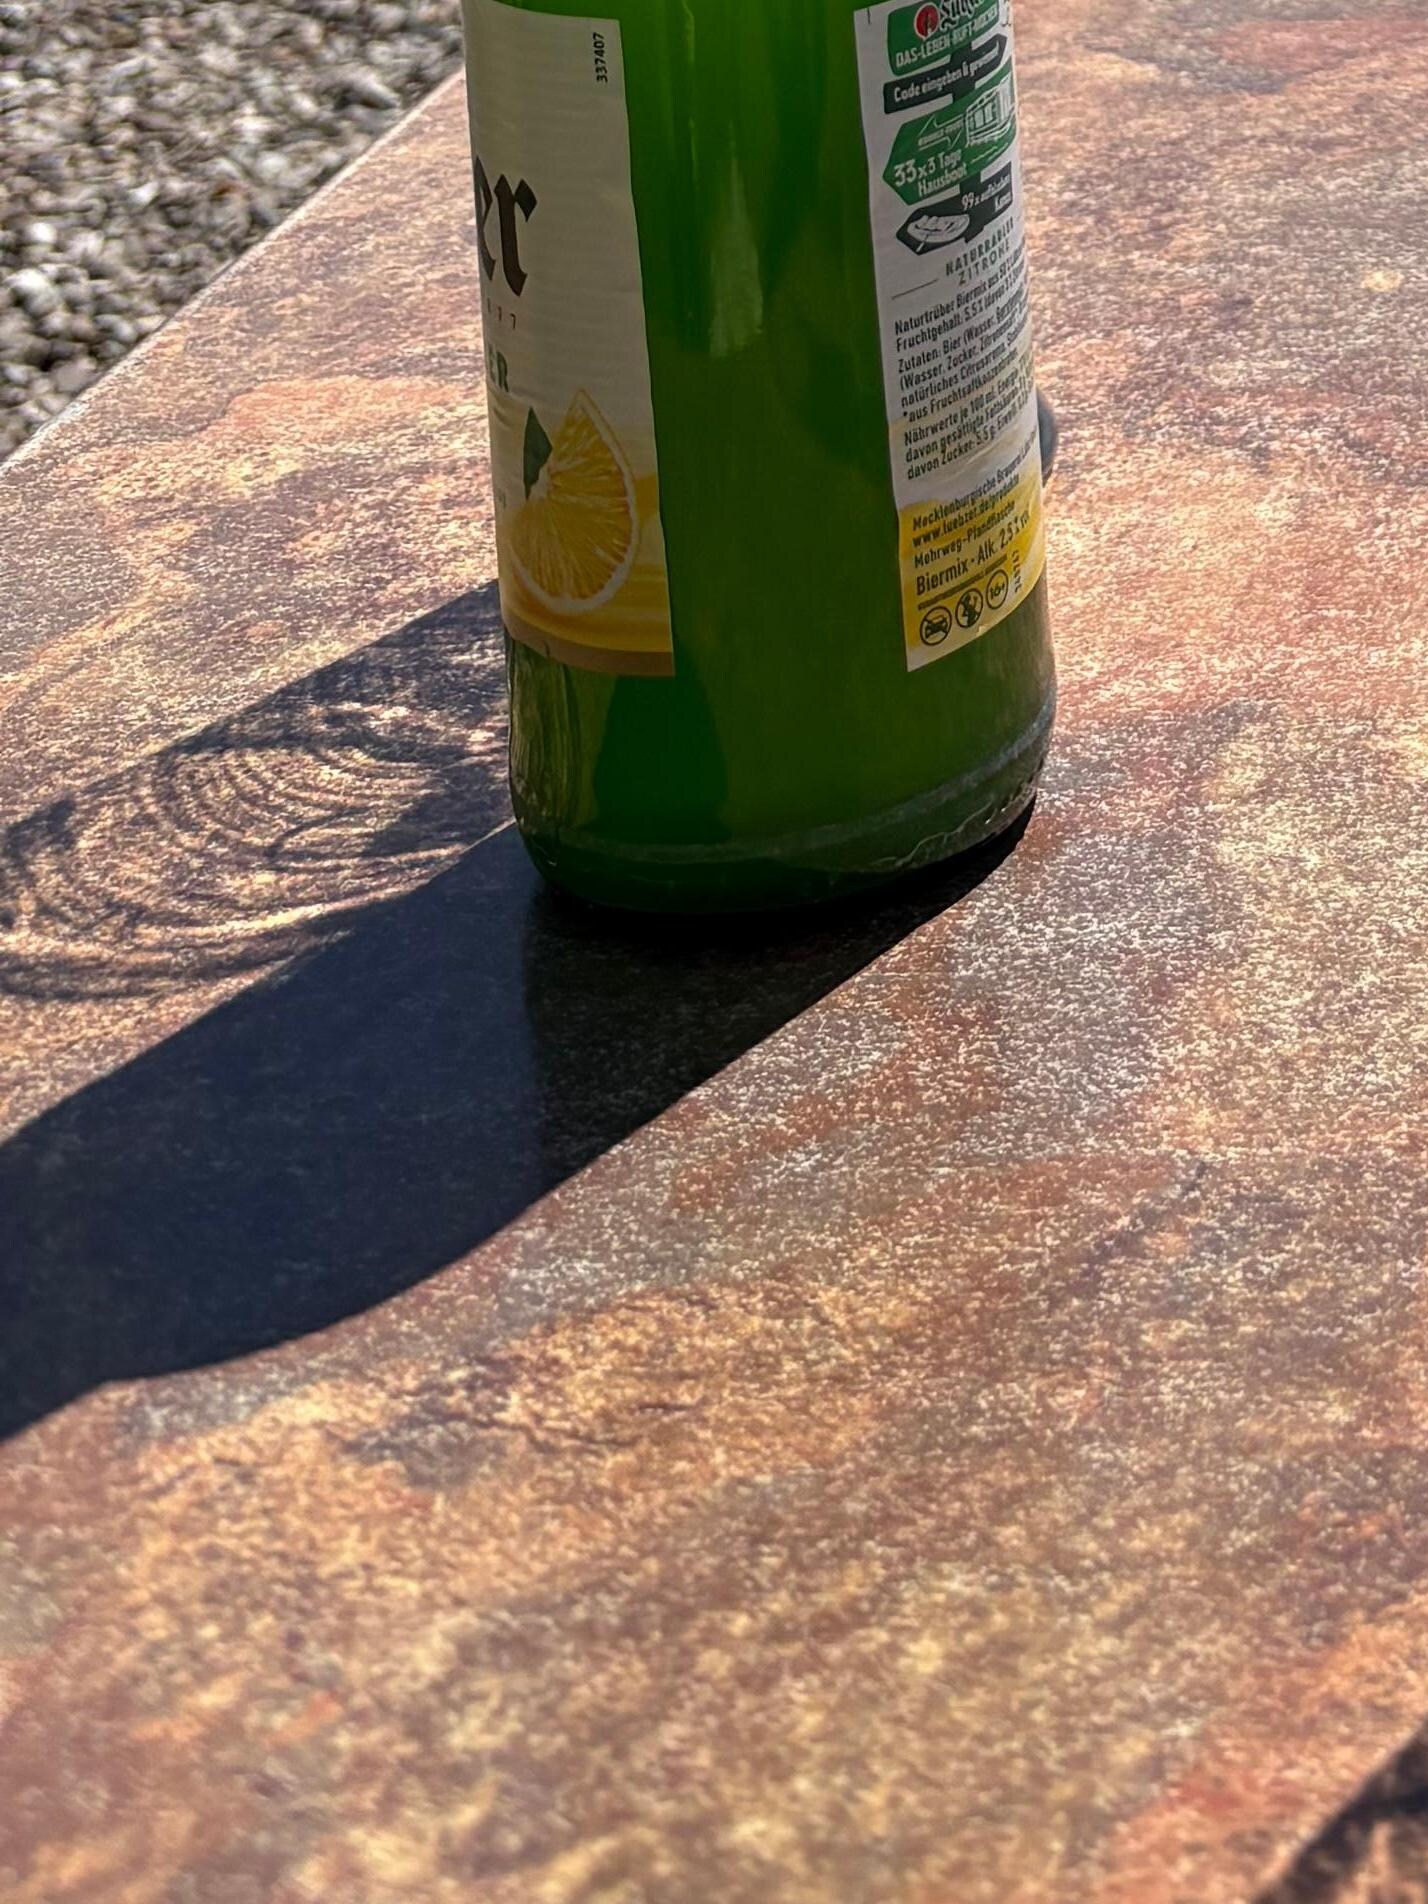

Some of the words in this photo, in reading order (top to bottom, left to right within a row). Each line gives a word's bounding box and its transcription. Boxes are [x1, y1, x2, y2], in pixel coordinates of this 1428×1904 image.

[592, 31, 608, 83] 337407
[894, 81, 921, 102] Code
[917, 162, 968, 199] Hausboot
[905, 439, 940, 464] davon
[907, 457, 940, 481] davon
[916, 557, 970, 597] Biermix
